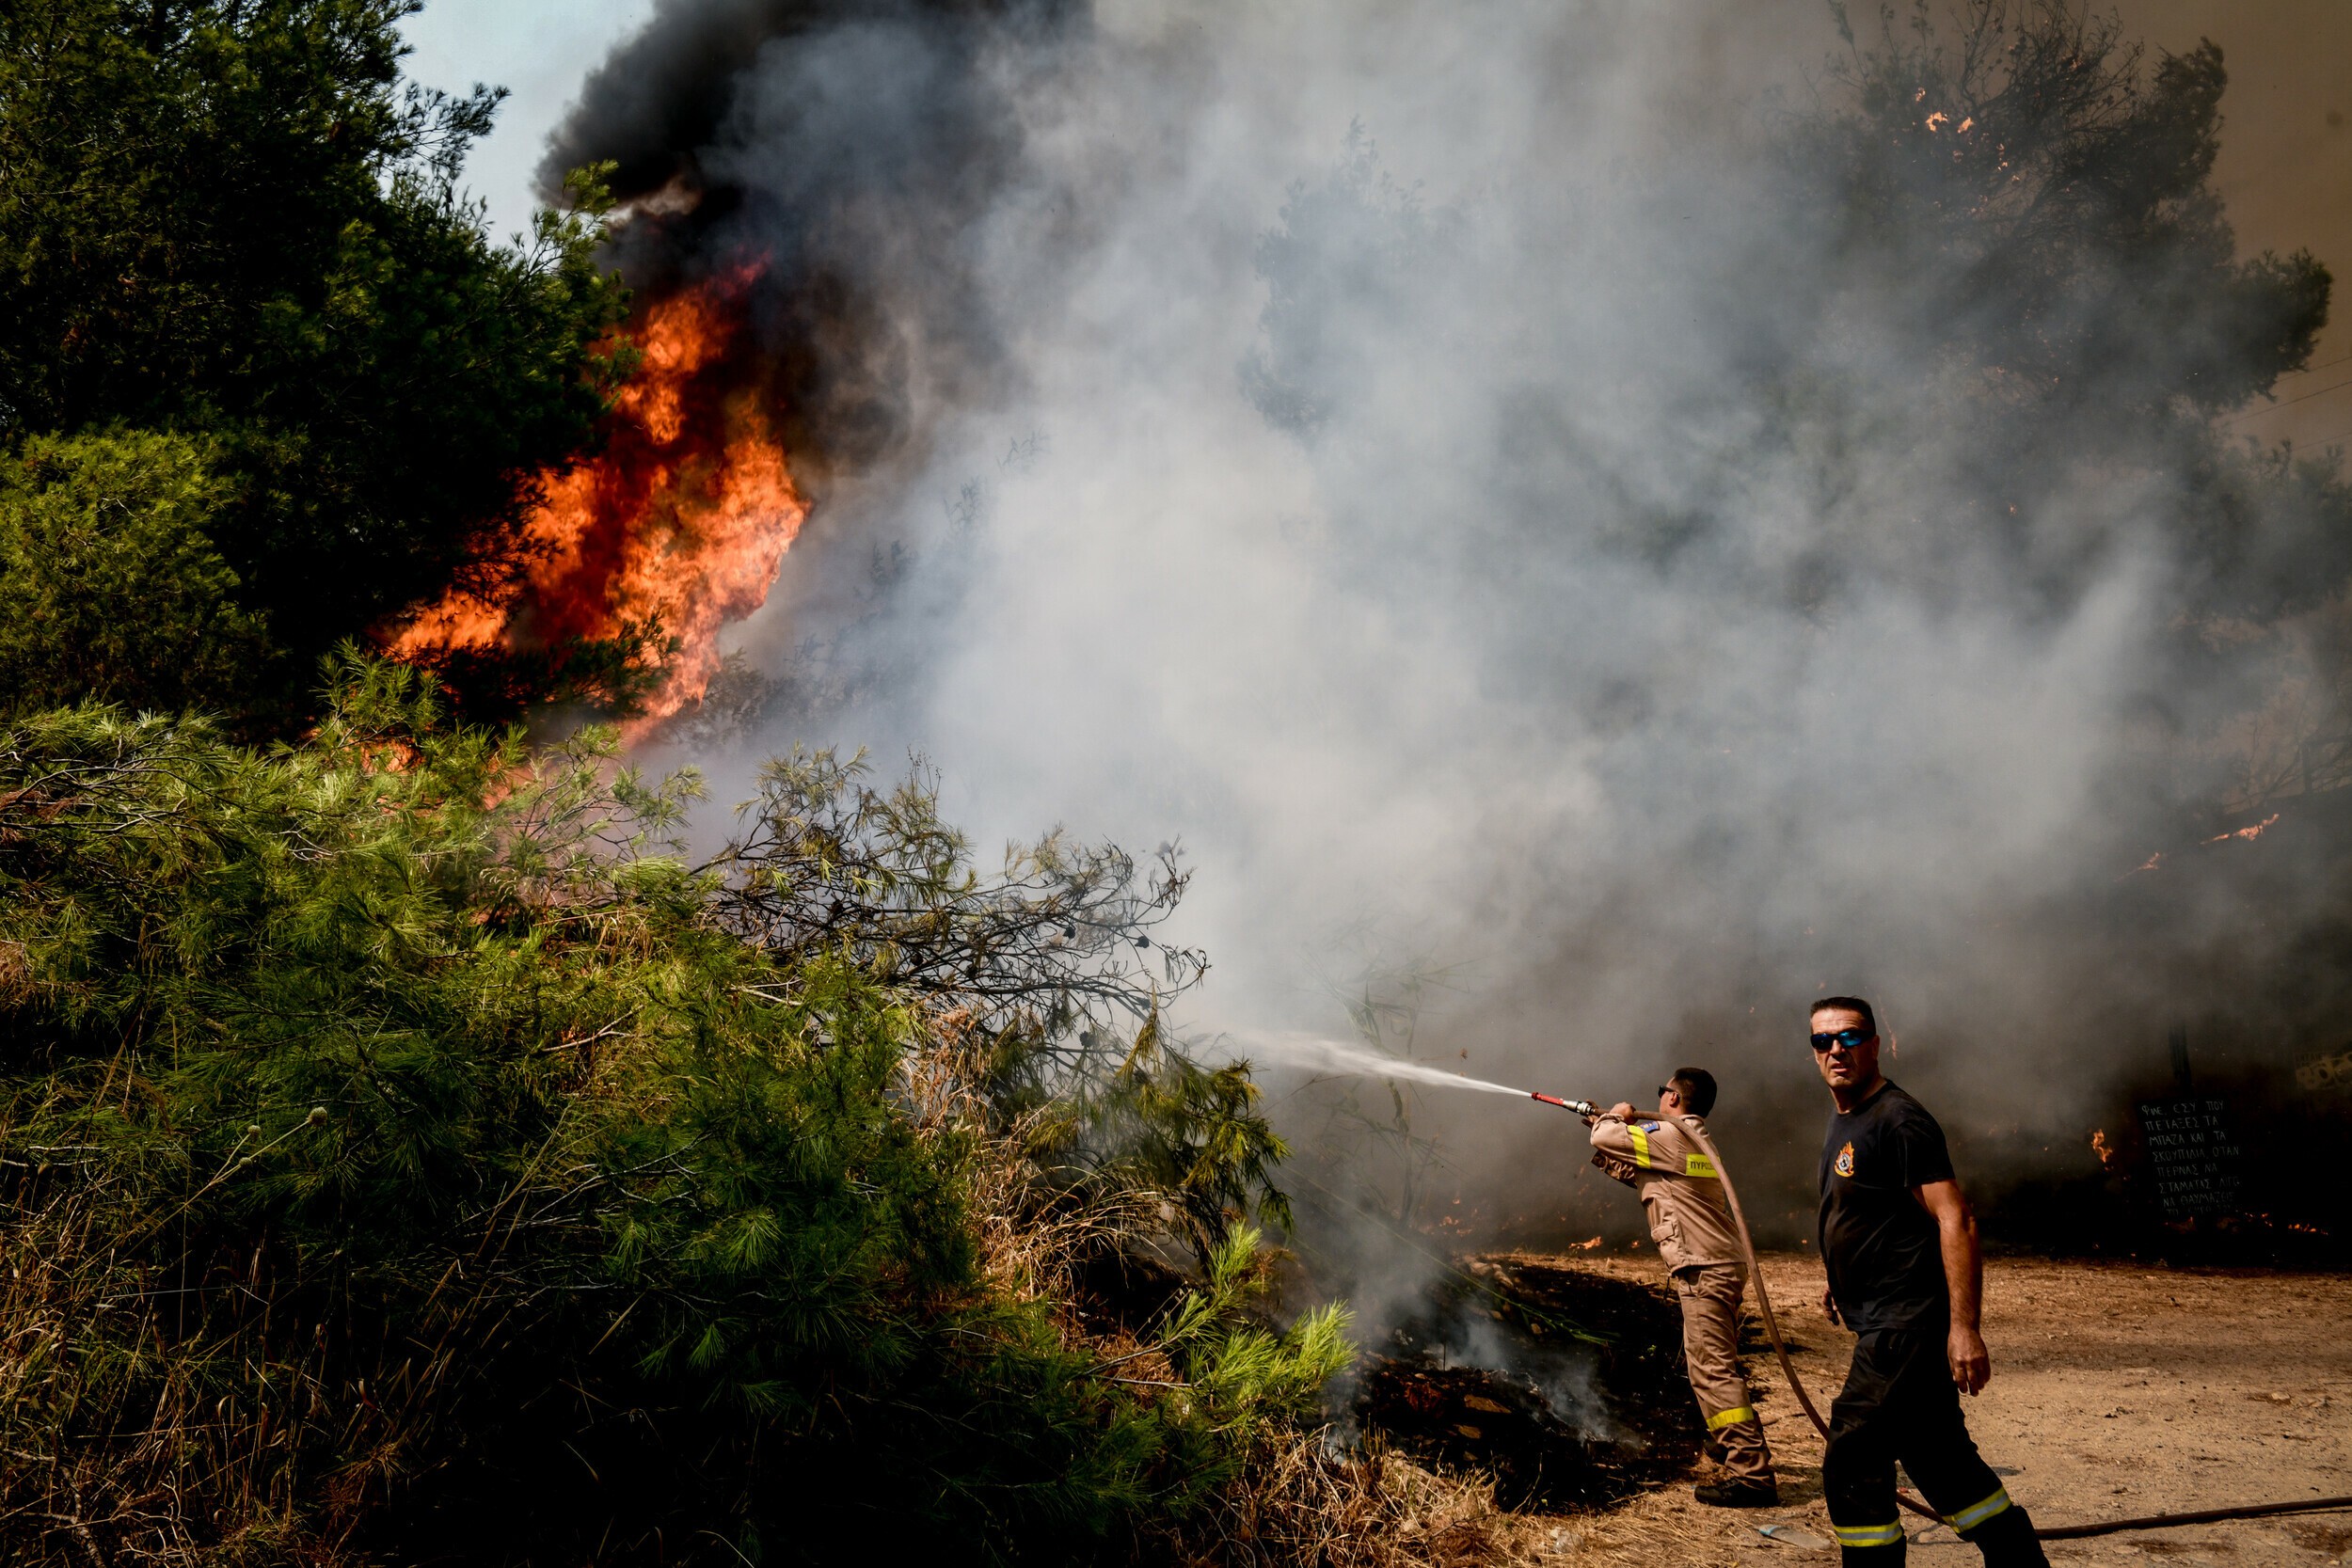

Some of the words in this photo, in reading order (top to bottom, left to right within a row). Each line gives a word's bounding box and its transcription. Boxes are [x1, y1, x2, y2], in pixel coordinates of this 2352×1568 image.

[2172, 1101, 2196, 1114] ΕΣΥ
[2205, 1100, 2224, 1111] ΠΟΥ
[2144, 1117, 2200, 1131] ΠΕΤΑΞΕΣ
[2202, 1115, 2219, 1126] ΤΑ
[2149, 1133, 2185, 1147] ΜΠΑΖΑ
[2189, 1132, 2205, 1143] ΚΑΙ
[2213, 1131, 2226, 1141] ΤΑ
[2212, 1146, 2239, 1157] ΟΤΑΝ
[2156, 1164, 2199, 1177] ΠΕΡΝΑΣ
[2204, 1163, 2217, 1173] ΝΑ
[2158, 1179, 2211, 1194] ΣΤΑΜΑΤΑΣ
